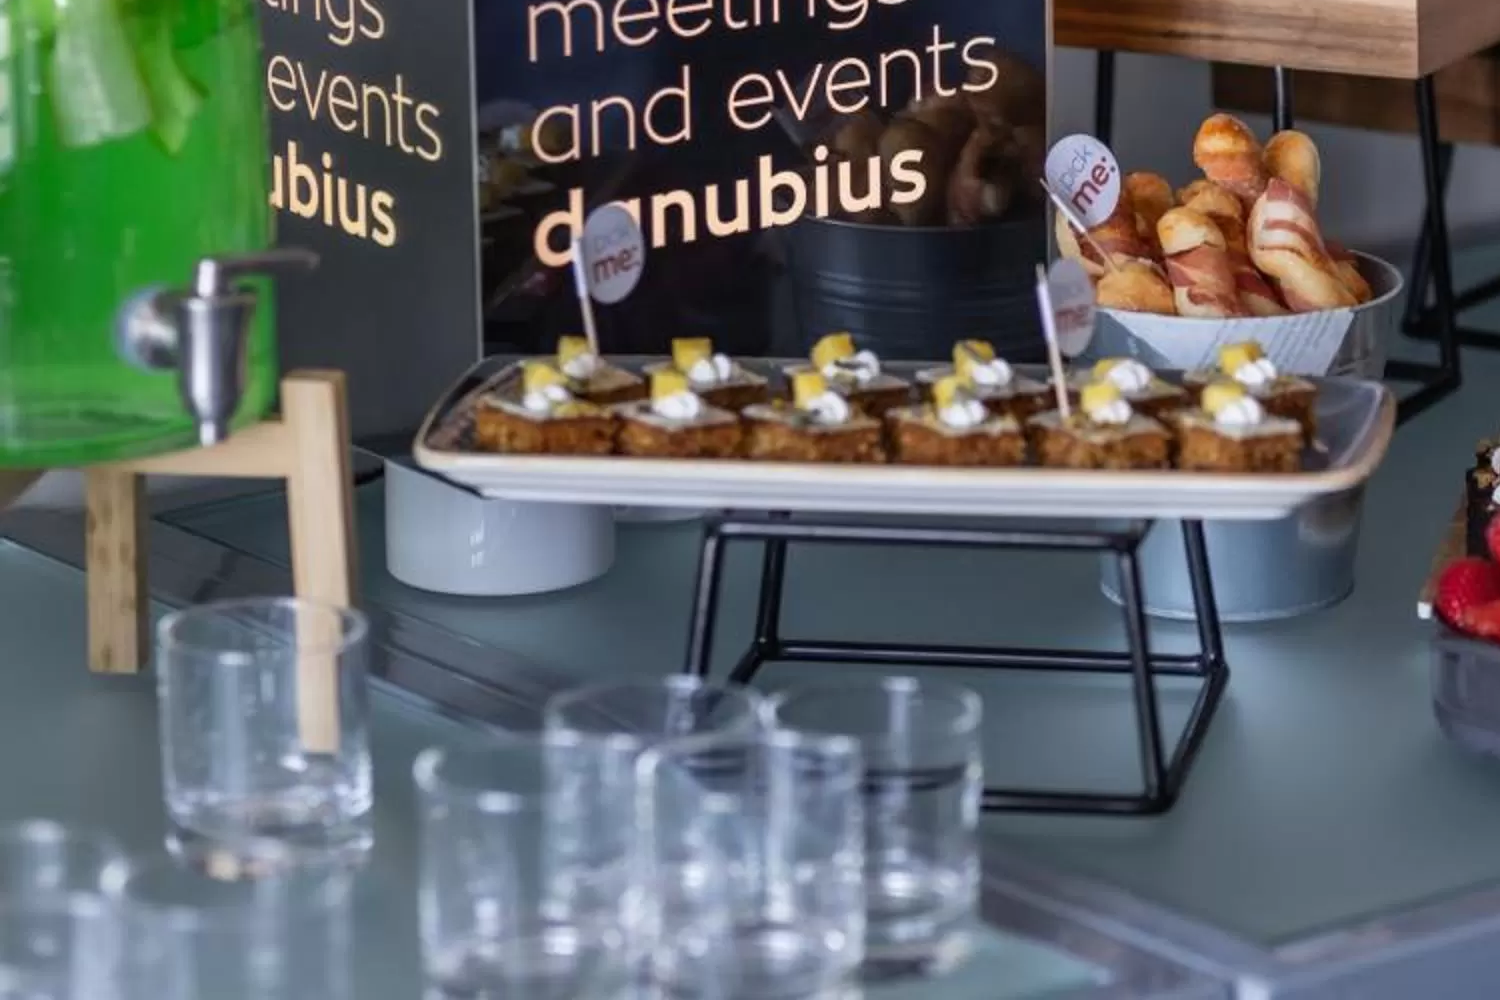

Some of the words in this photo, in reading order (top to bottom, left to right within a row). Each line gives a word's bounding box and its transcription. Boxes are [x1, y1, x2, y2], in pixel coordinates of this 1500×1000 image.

[267, 55, 442, 161] events
[532, 65, 692, 163] and
[728, 25, 999, 130] events
[268, 139, 397, 247] bius
[1071, 155, 1116, 216] me:
